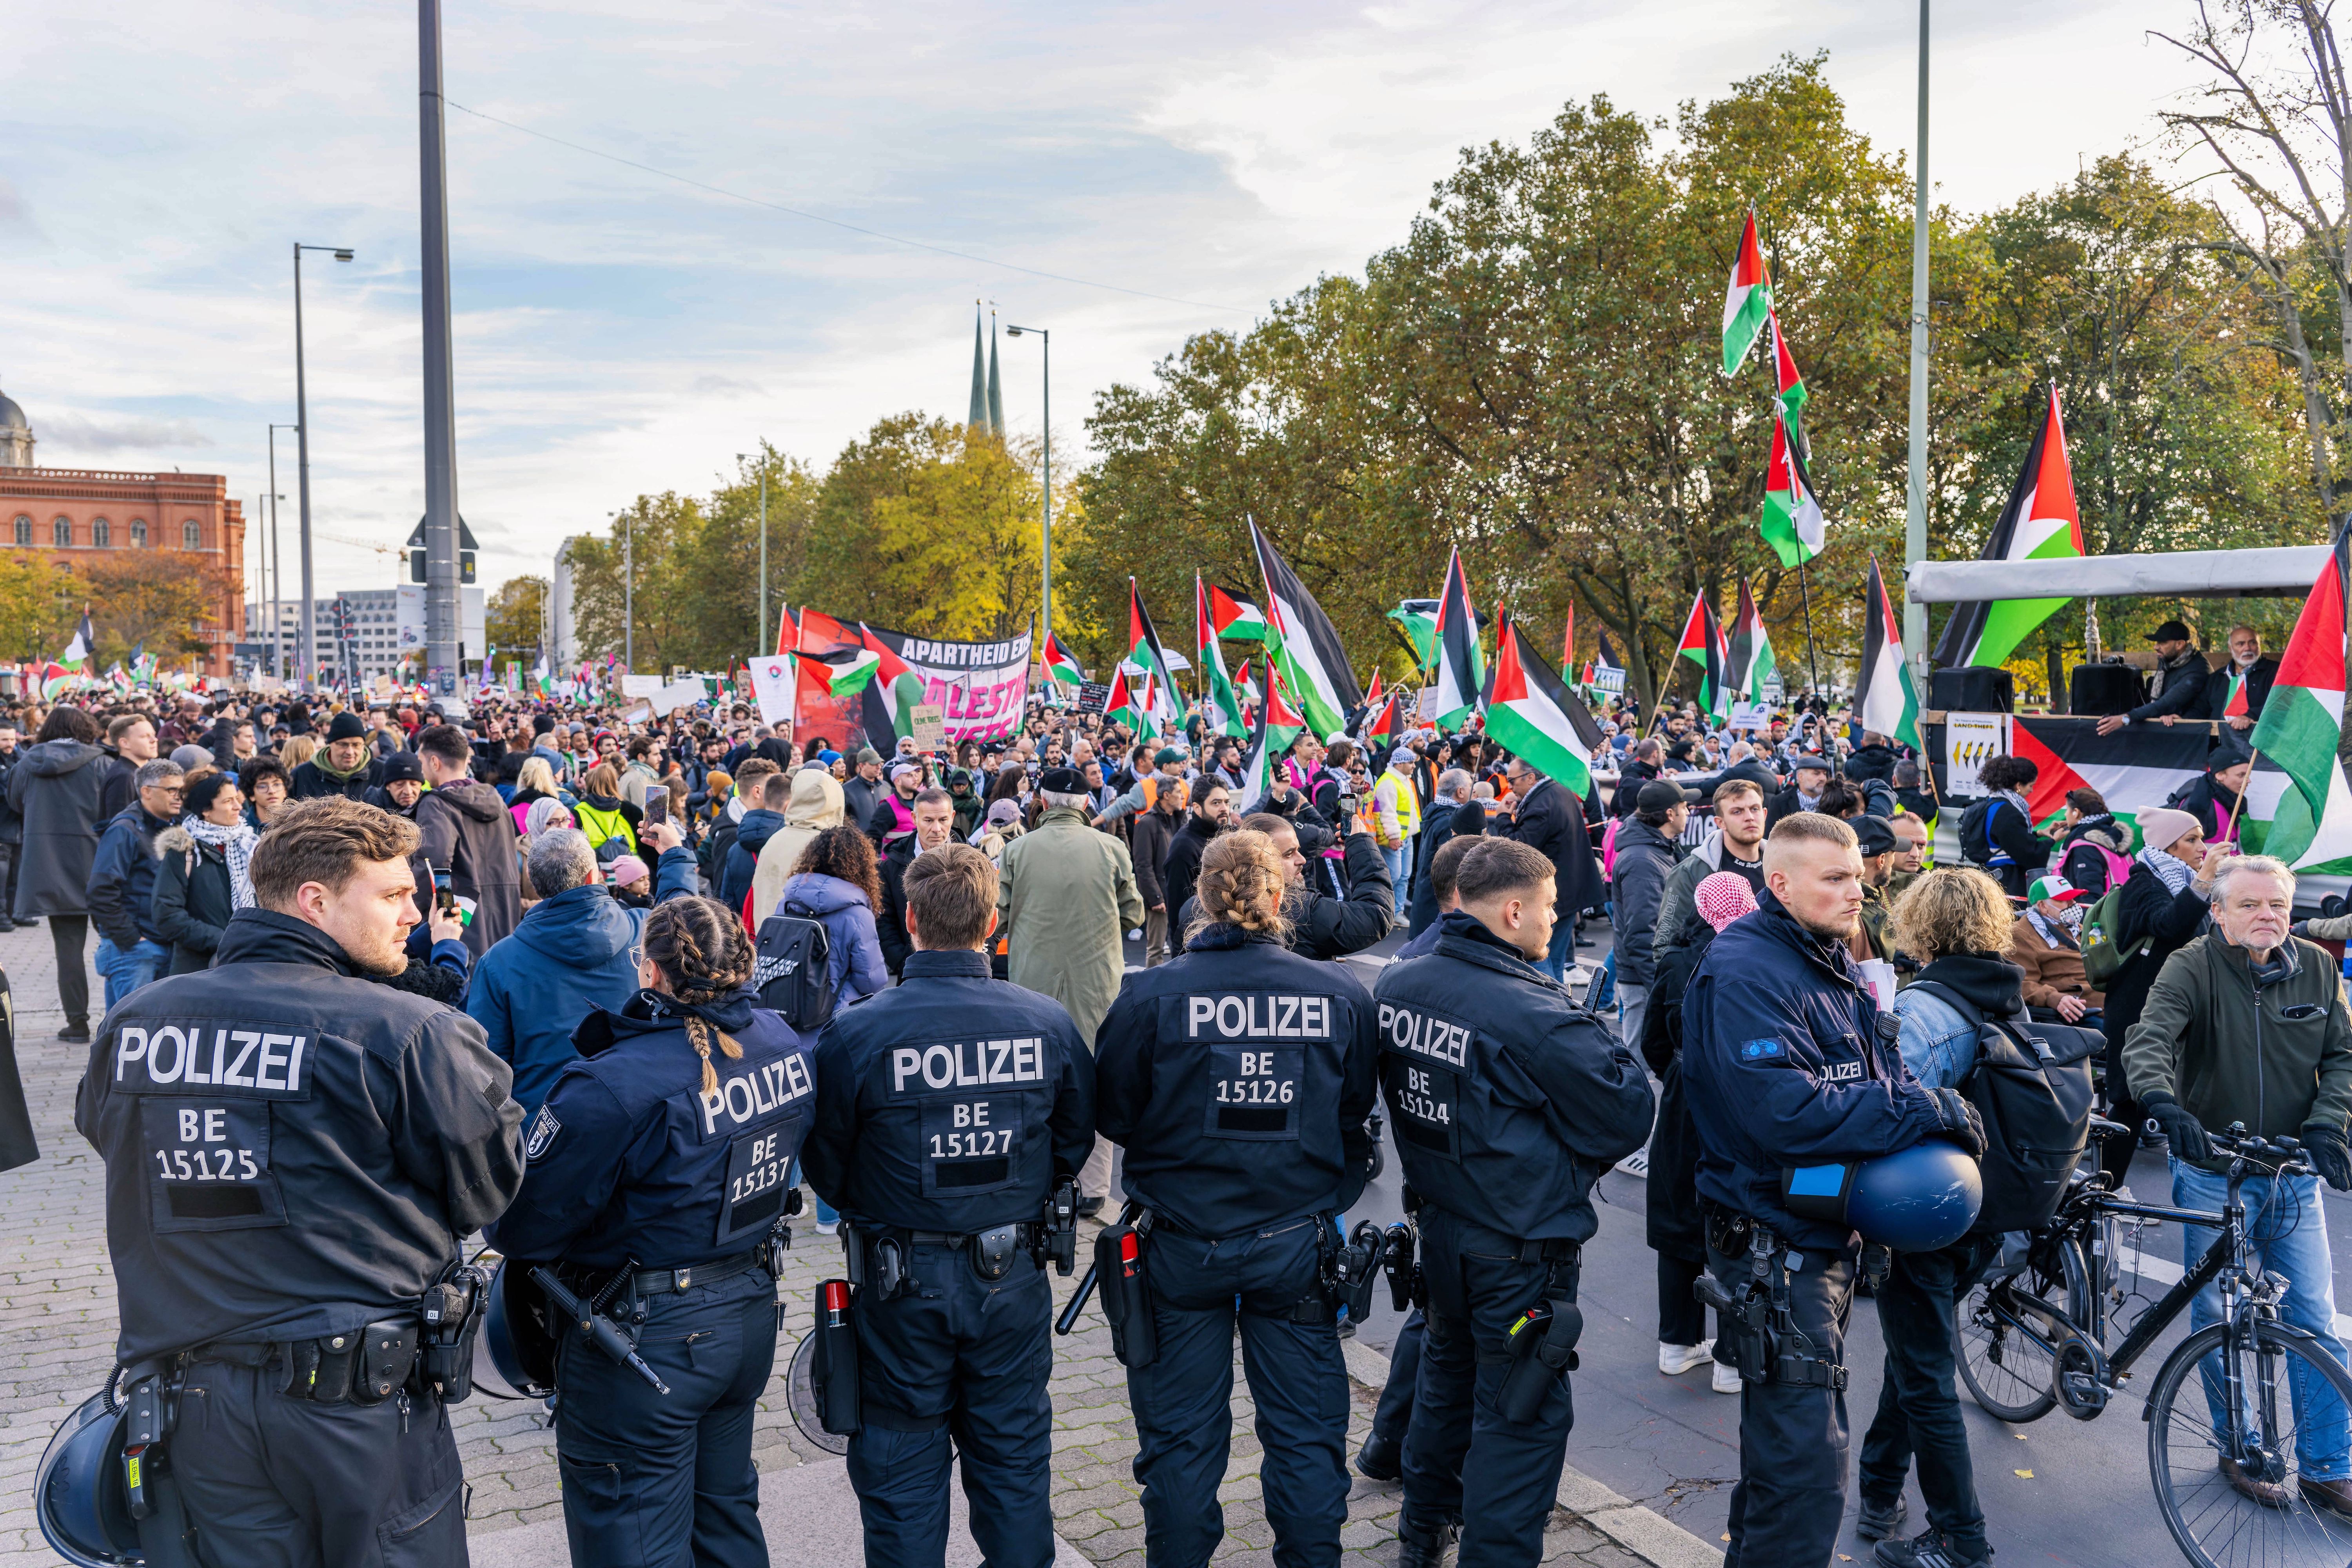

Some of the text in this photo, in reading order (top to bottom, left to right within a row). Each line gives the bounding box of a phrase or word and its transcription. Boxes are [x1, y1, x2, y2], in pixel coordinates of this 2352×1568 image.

[901, 639, 1010, 666] APARTHEID
[1679, 815, 1717, 846] tine
[1734, 858, 1745, 867] Los
[1190, 996, 1329, 1037] POLIZEI
[1379, 1004, 1470, 1067] POLIZEI
[117, 1026, 306, 1091] POLIZEI
[893, 1038, 1043, 1091] POLIZEI
[1241, 1052, 1274, 1076] BE
[1819, 1062, 1862, 1082] OLIZEI
[698, 1052, 813, 1134] POLIZEI
[1217, 1080, 1293, 1103] 15126
[1408, 1067, 1430, 1096] BE
[540, 1109, 557, 1132] POLIZEI
[954, 1102, 989, 1127] BE
[1398, 1089, 1450, 1125] 15124
[179, 1109, 226, 1142] BE
[751, 1132, 777, 1167] BE
[931, 1130, 1012, 1158] 15127
[156, 1149, 258, 1180] 15125
[731, 1155, 789, 1203] 15137
